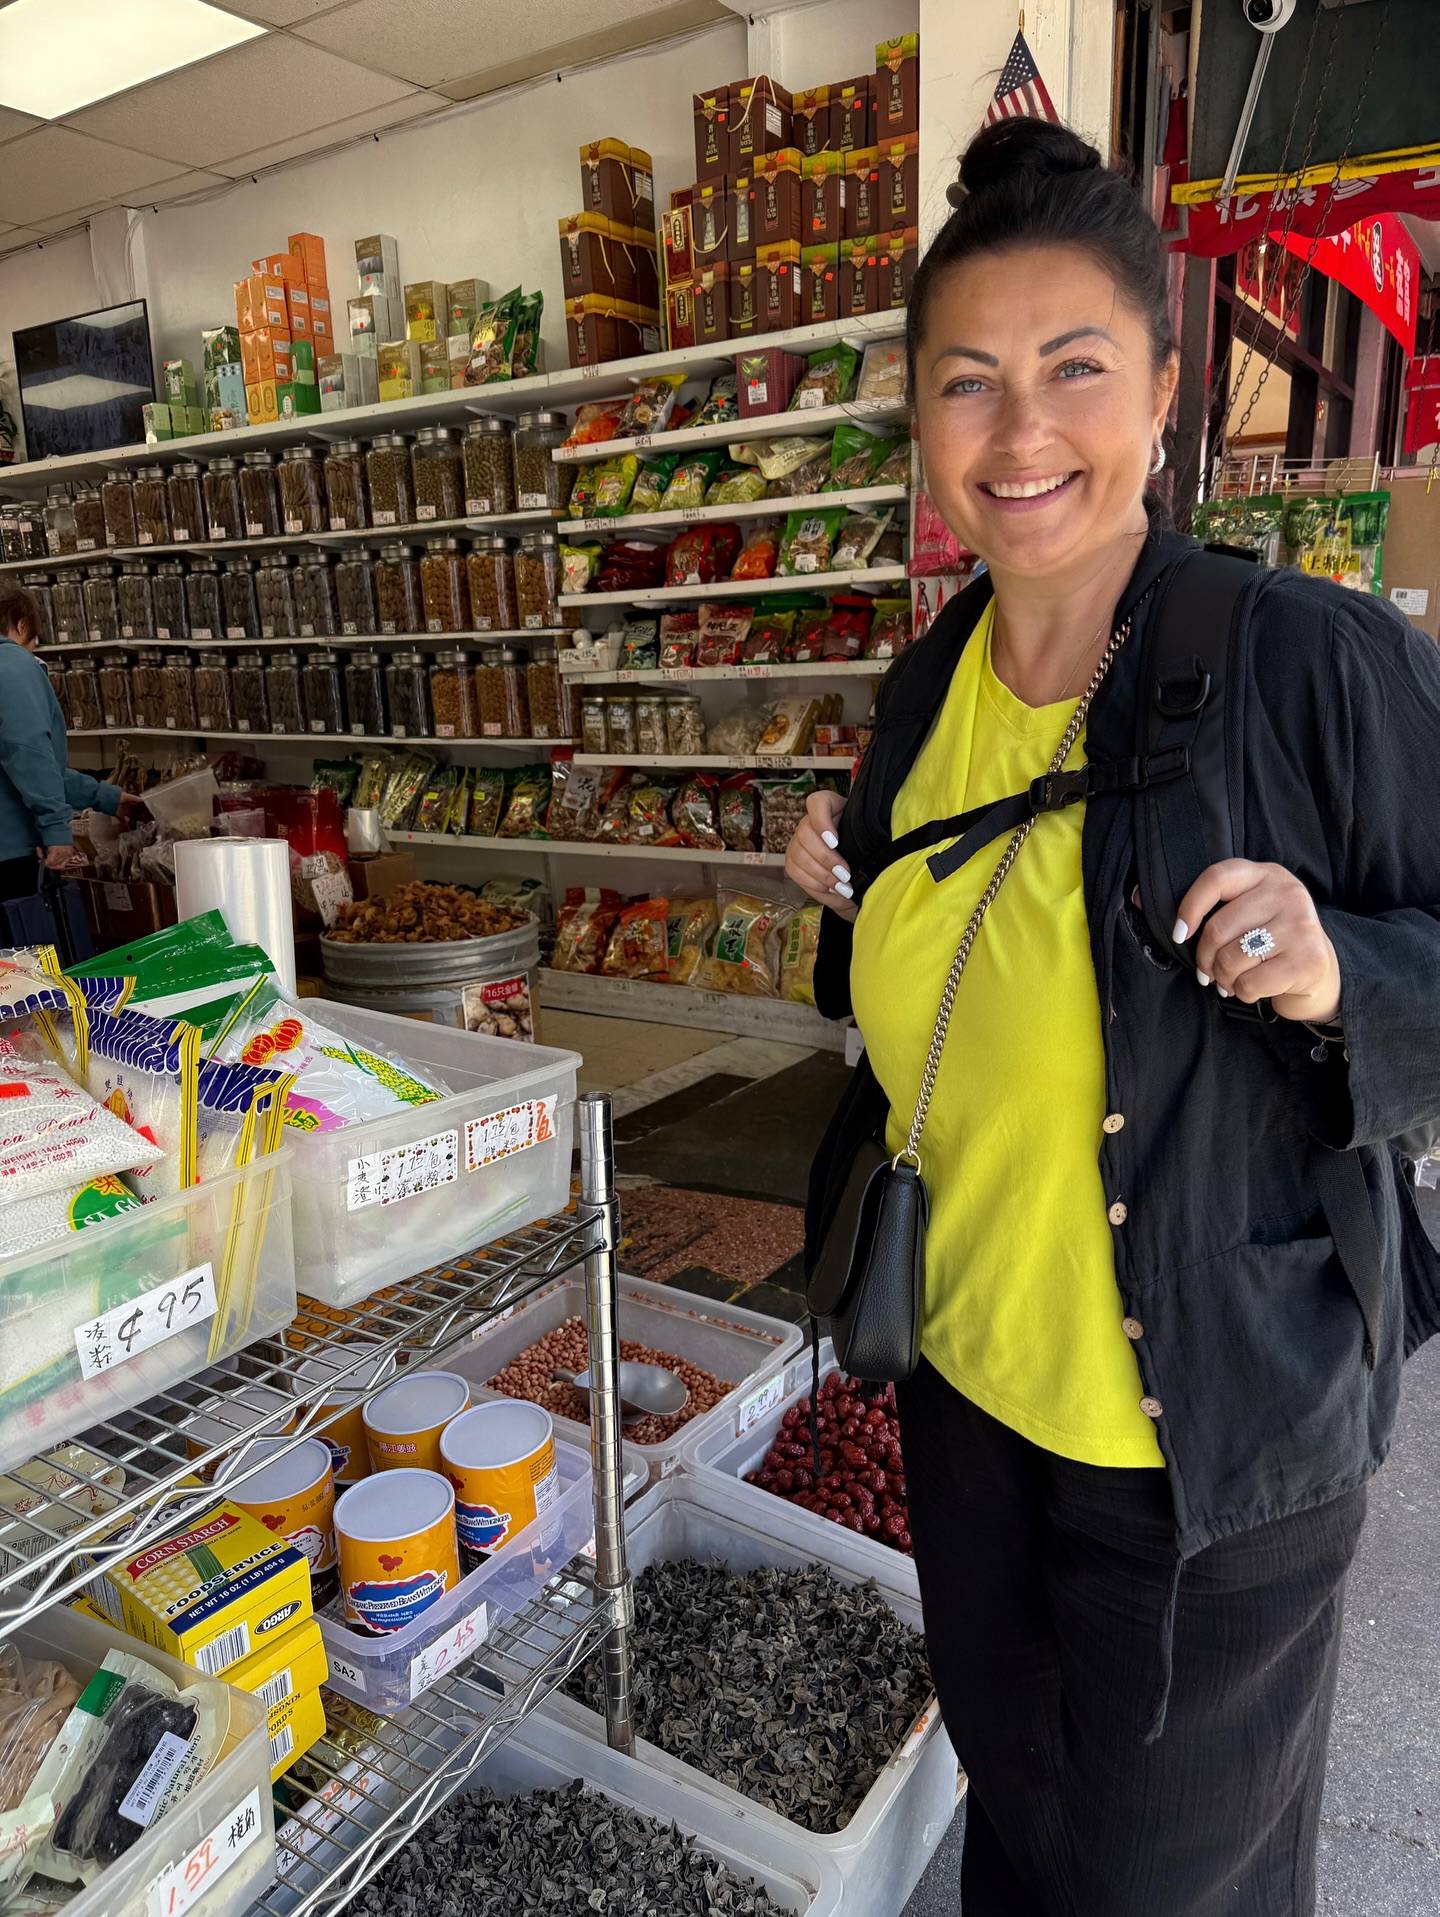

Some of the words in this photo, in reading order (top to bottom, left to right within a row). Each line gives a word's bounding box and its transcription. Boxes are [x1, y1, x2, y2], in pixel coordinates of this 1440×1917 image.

[135, 1542, 178, 1570] CORN
[176, 1518, 230, 1548] STARCH
[165, 1542, 284, 1616] FOODSERVICE
[188, 1604, 205, 1619] NET
[203, 1596, 218, 1609] WT
[218, 1588, 230, 1600] 16
[229, 1582, 242, 1594] OZ
[250, 1568, 264, 1582] LB)
[264, 1560, 278, 1574] 454
[263, 1603, 293, 1630] ARGO
[333, 1660, 357, 1682] SA2
[164, 1760, 187, 1797] Natural
[184, 1734, 202, 1760] Herb
